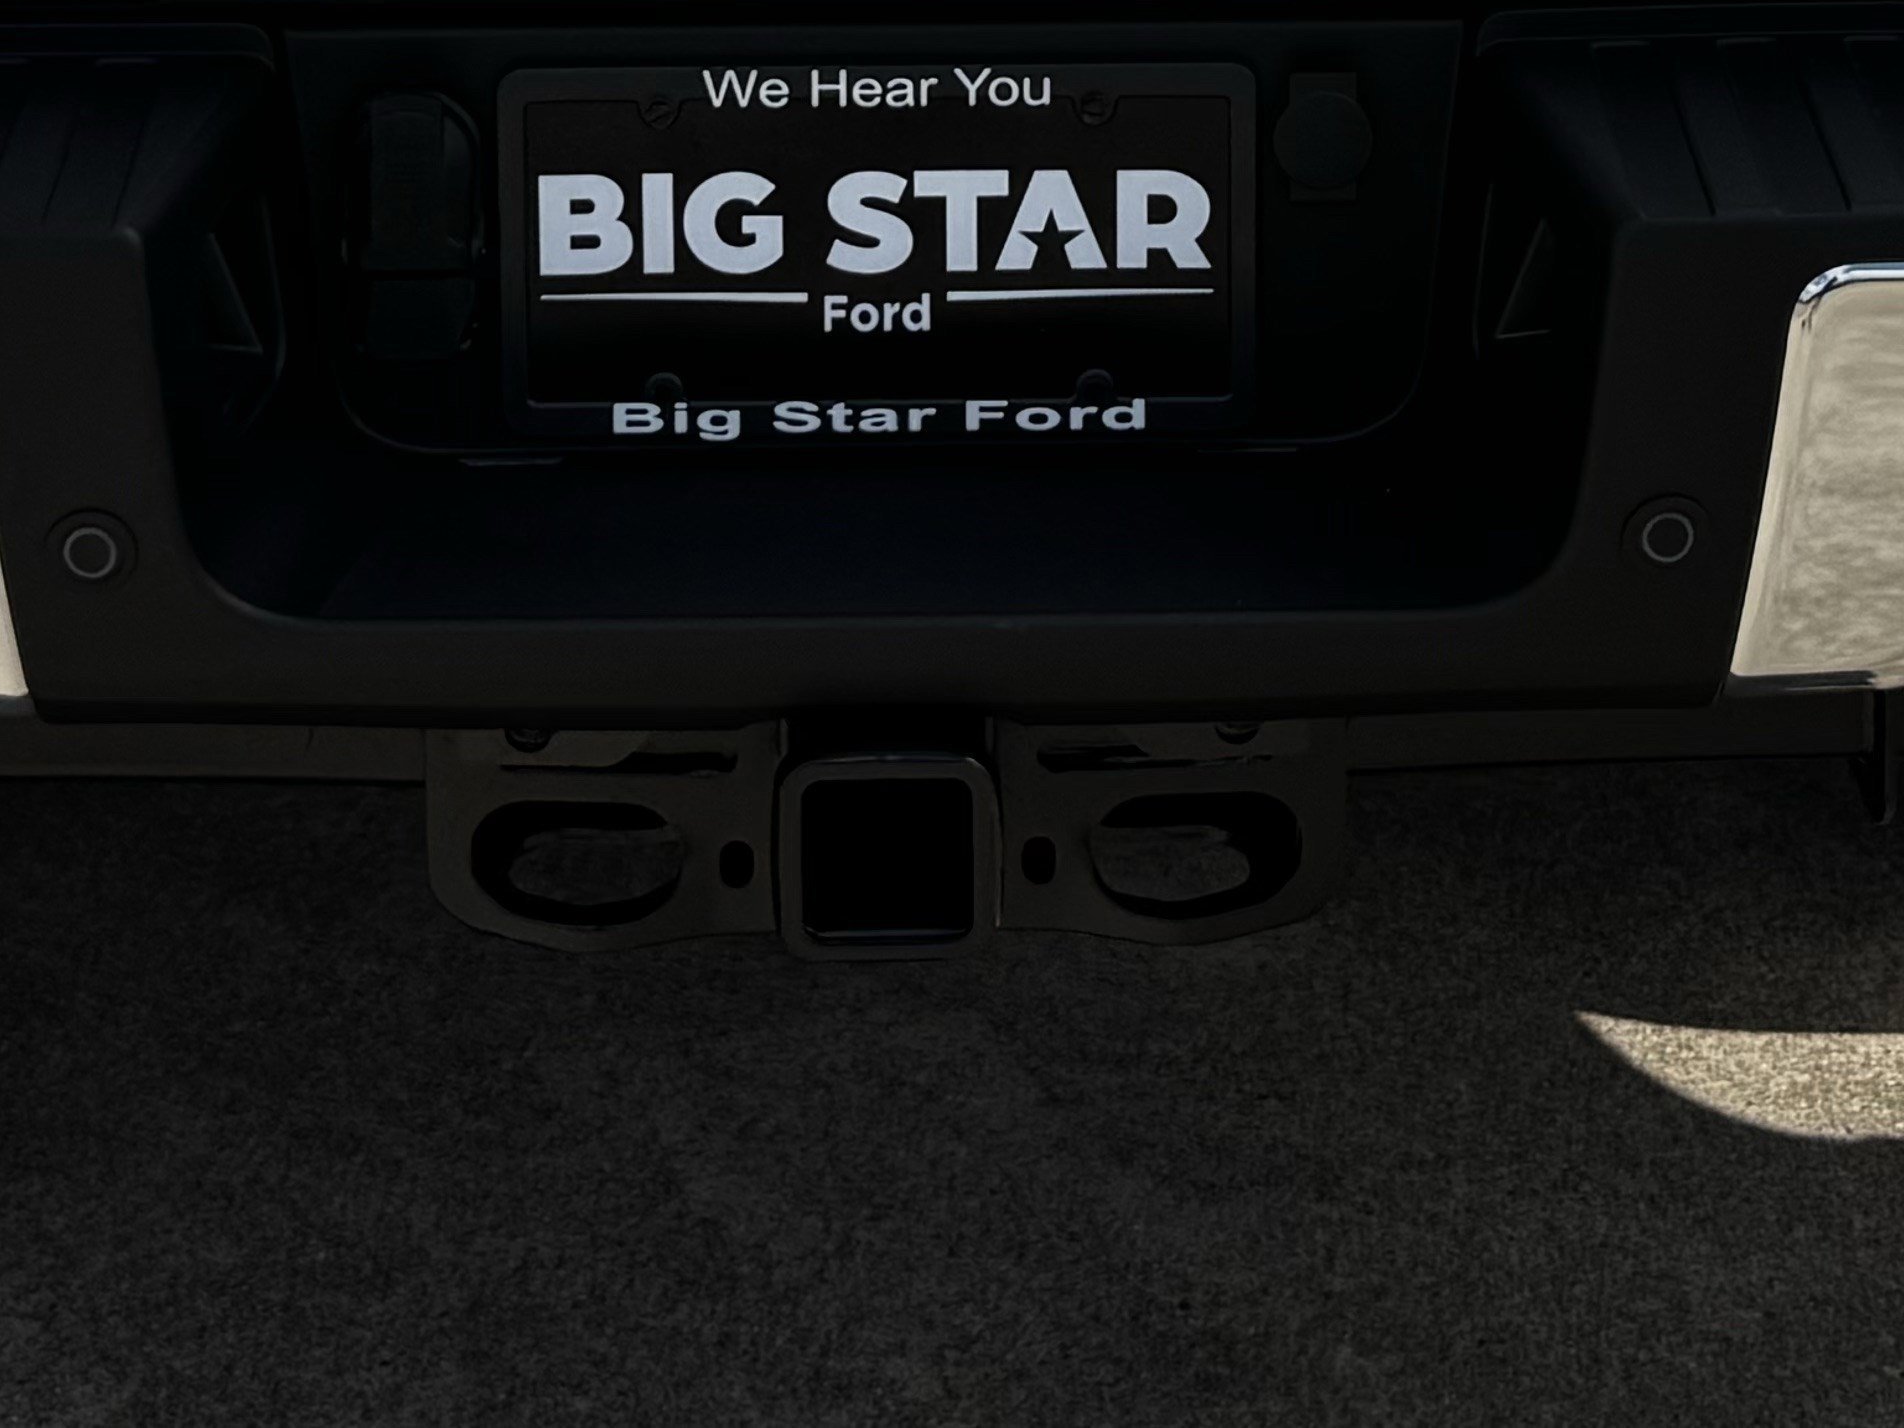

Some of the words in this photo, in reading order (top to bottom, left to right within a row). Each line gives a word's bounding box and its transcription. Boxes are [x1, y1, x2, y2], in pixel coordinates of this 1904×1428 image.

[702, 69, 790, 109] We
[810, 68, 939, 108] Hear
[953, 67, 1052, 107] You
[537, 171, 785, 276] BIG
[825, 169, 1213, 275] STAR
[823, 292, 932, 333] Ford
[612, 402, 742, 441] Big
[772, 400, 938, 433] Star
[964, 398, 1147, 432] Ford
